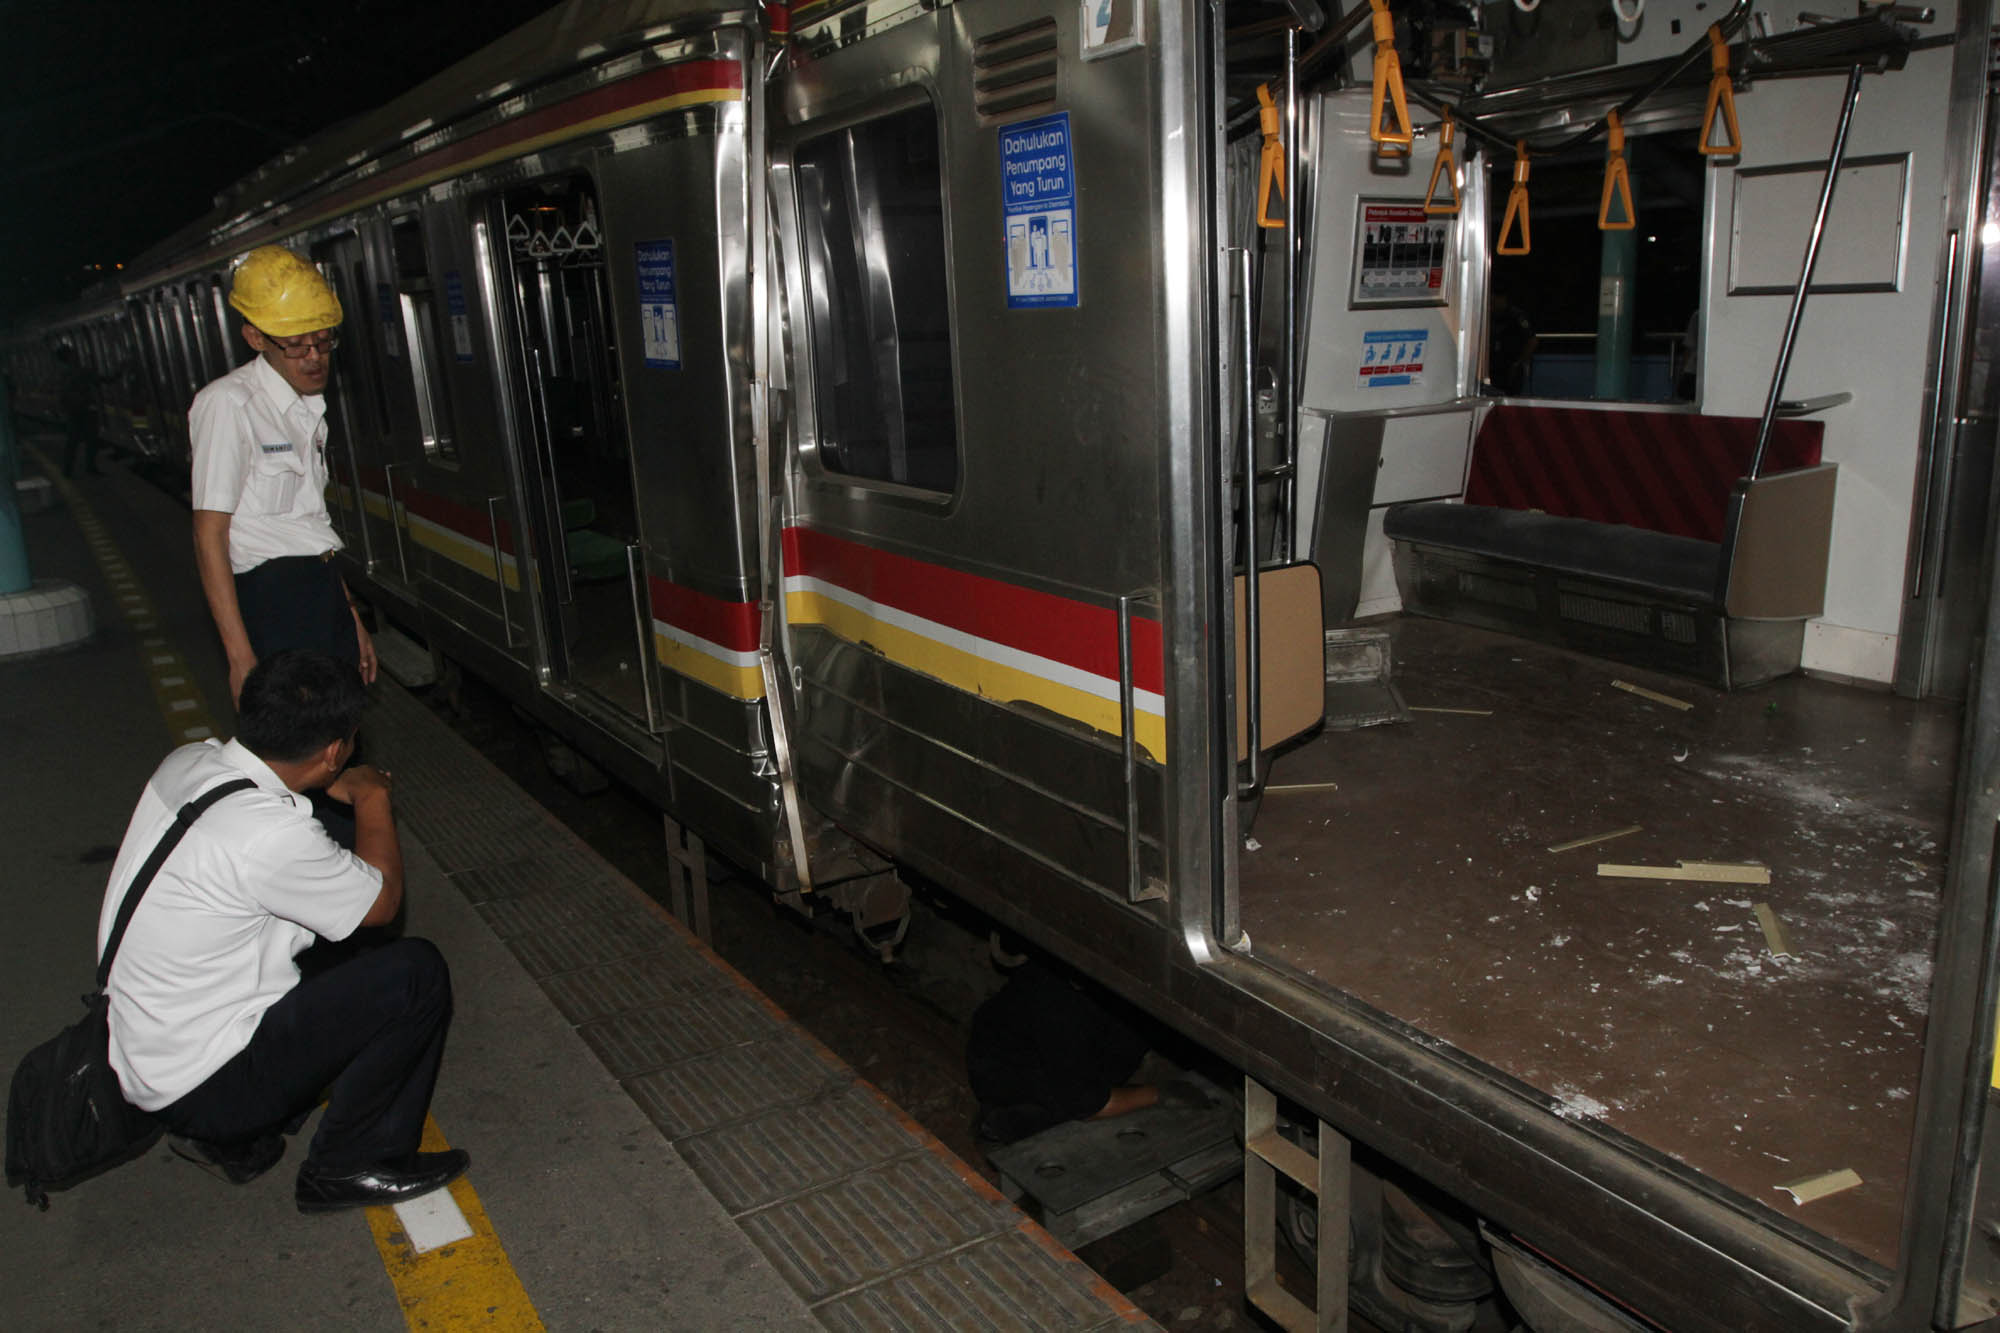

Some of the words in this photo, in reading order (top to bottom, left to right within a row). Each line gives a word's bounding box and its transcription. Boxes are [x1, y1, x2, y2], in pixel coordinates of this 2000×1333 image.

[1005, 131, 1064, 154] Dahulukan
[1006, 154, 1066, 176] Penumpang
[1010, 181, 1035, 197] Yang
[1037, 176, 1064, 192] Turun
